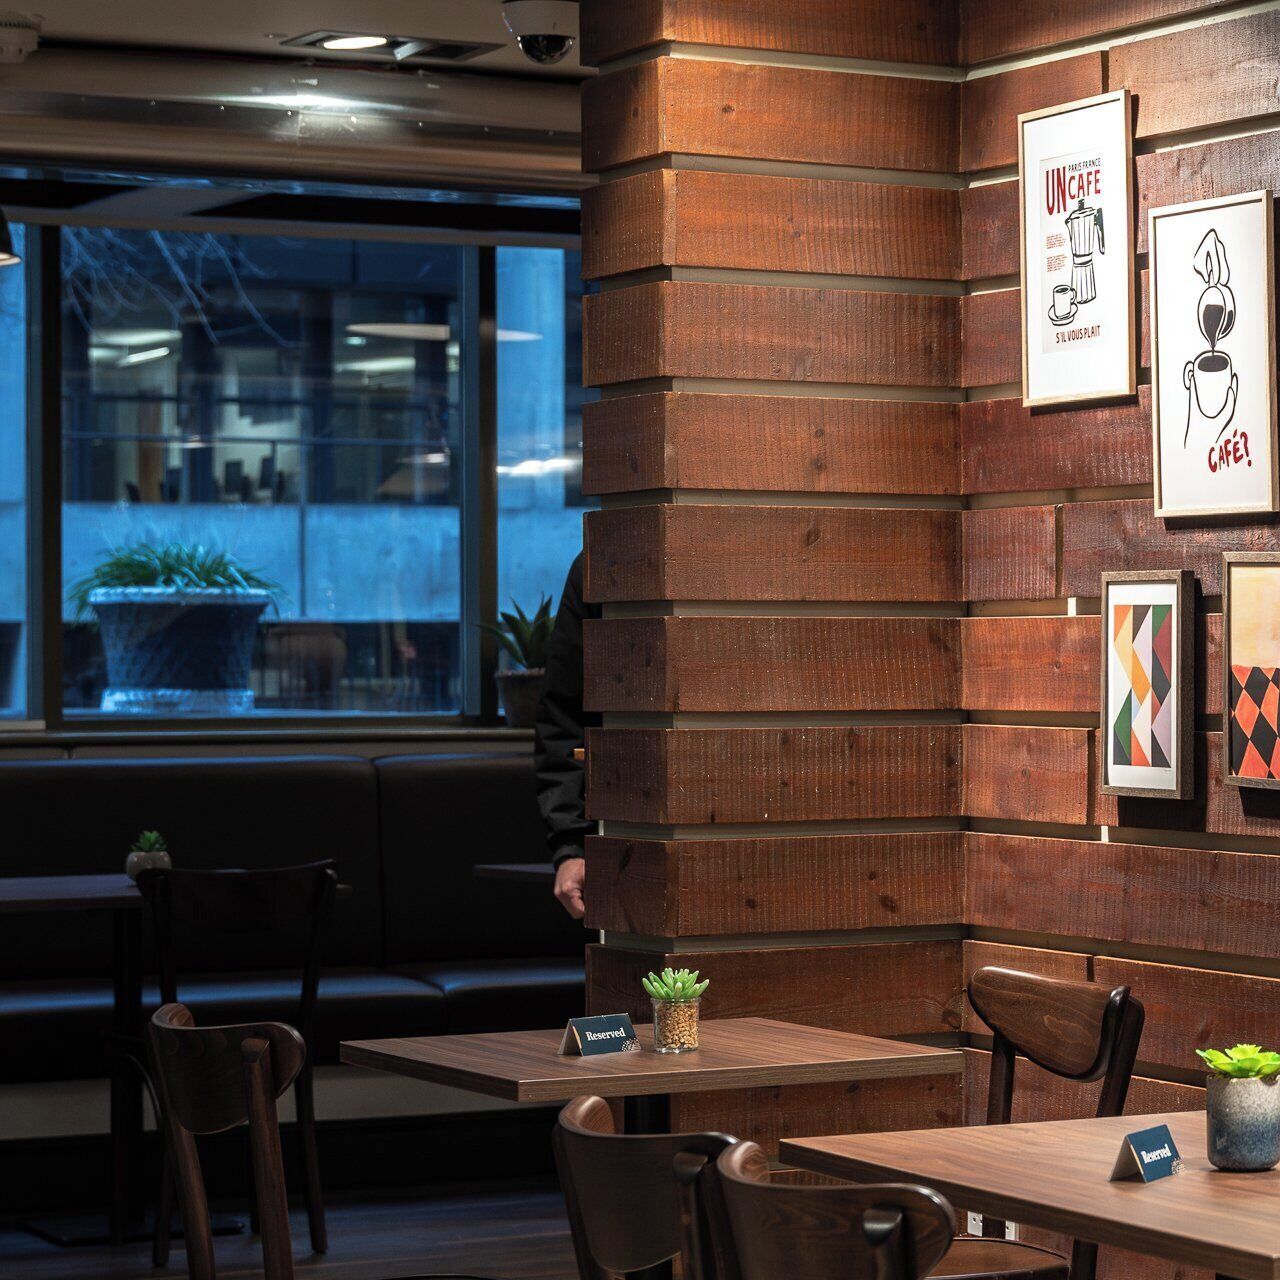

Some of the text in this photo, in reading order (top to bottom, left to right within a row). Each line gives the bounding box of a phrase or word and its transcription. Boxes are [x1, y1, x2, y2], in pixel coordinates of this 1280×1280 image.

[1046, 166, 1066, 215] UN
[1068, 170, 1101, 200] CAFE
[1067, 329, 1083, 342] VOUS
[1208, 429, 1252, 473] CAFÉ?
[585, 1027, 626, 1041] Reserved
[1141, 1143, 1172, 1164] Reserved
